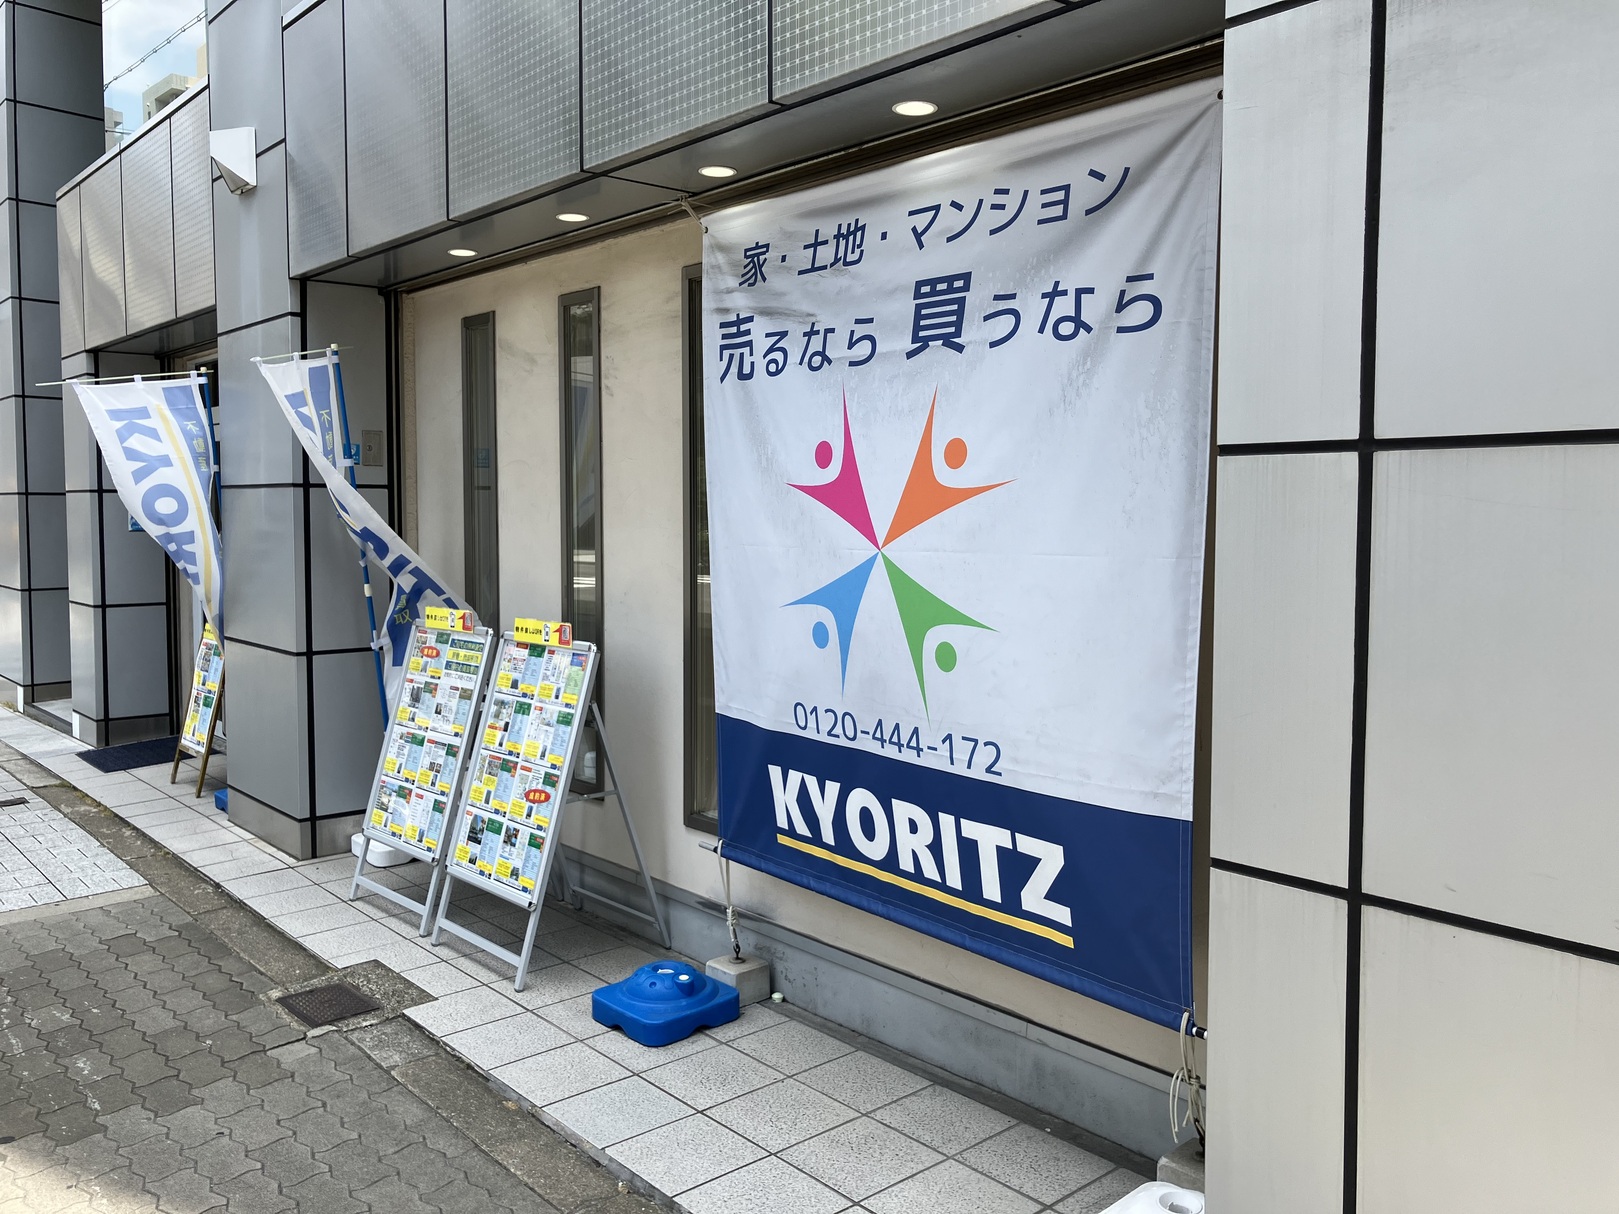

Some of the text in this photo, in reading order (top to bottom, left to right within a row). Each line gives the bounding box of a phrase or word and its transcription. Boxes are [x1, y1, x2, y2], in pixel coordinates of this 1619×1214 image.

[738, 166, 1131, 288] 家・土地・マンション
[718, 271, 1164, 385] 売るなら 買うなら
[792, 701, 1004, 777] 0120-444-172
[766, 764, 1073, 928] KYORITZ
